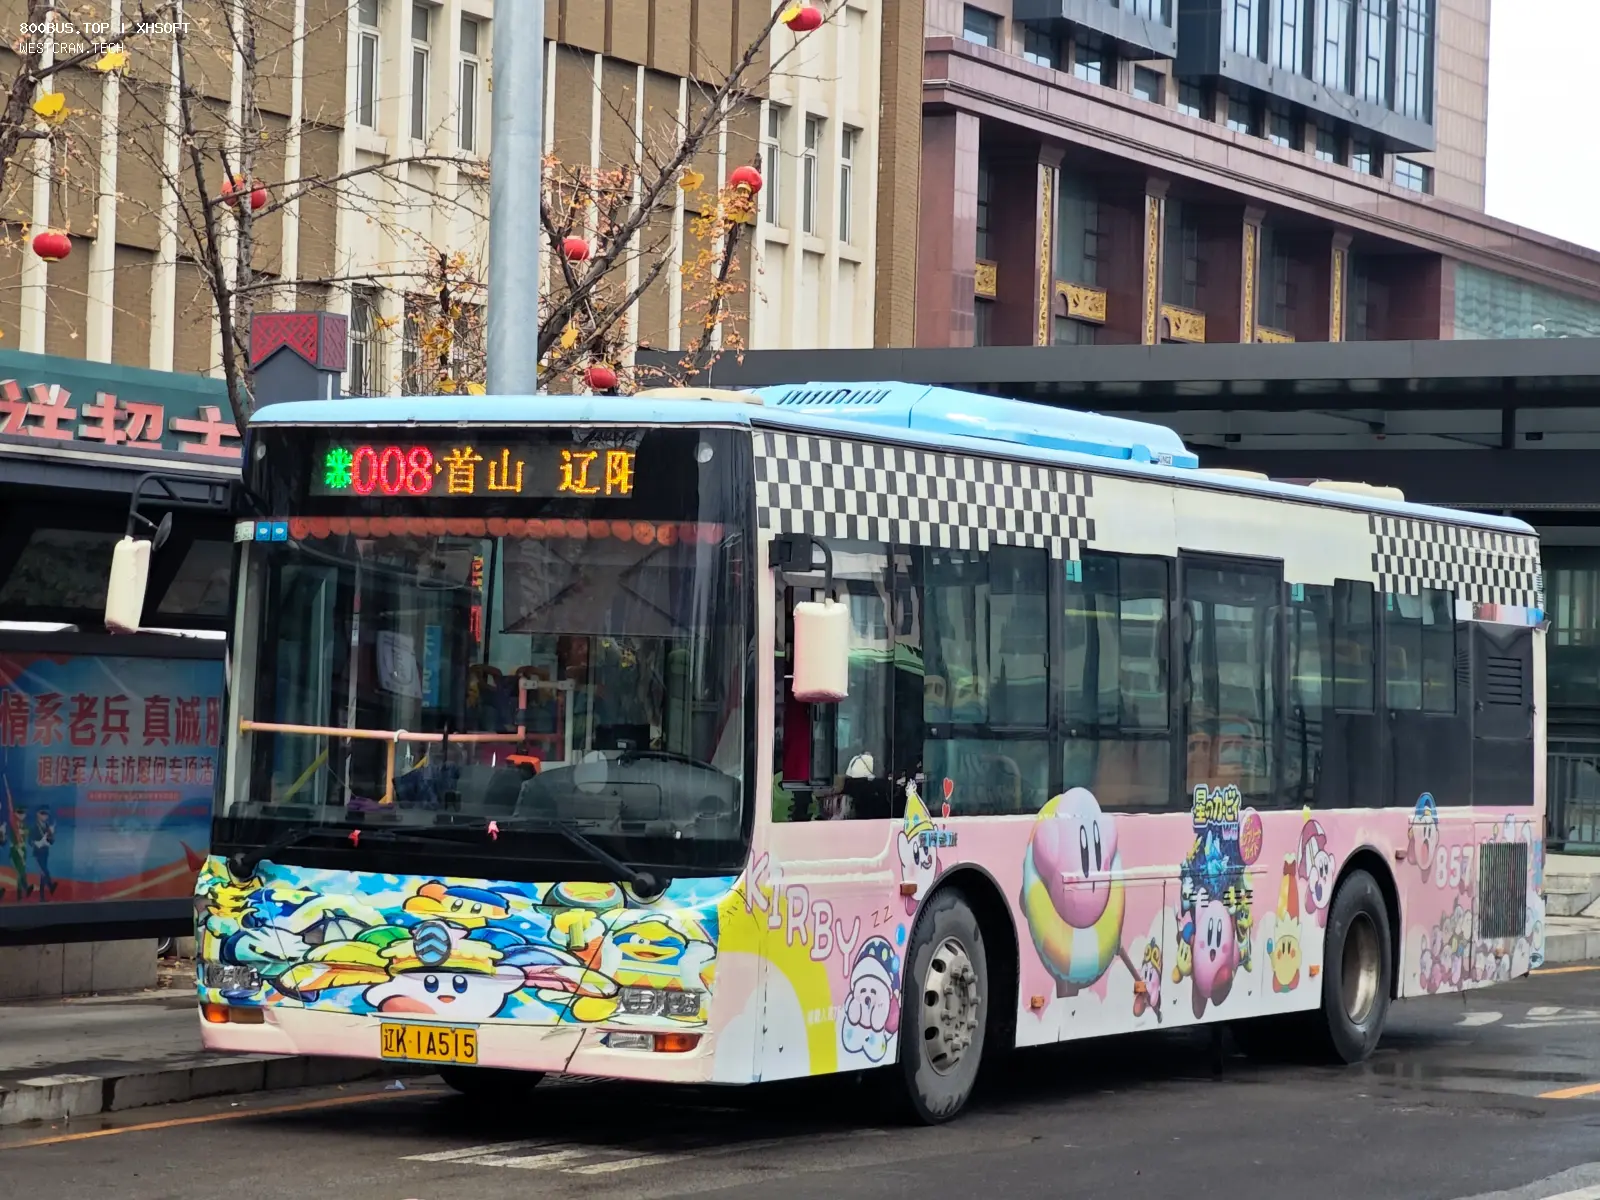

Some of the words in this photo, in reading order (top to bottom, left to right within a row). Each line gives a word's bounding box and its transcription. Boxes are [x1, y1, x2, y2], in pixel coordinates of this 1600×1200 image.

[351, 445, 435, 496] 008
[443, 445, 526, 495] 首山
[0, 688, 131, 748] 情系老兵
[1435, 843, 1475, 890] 857
[745, 847, 861, 979] KIRBY
